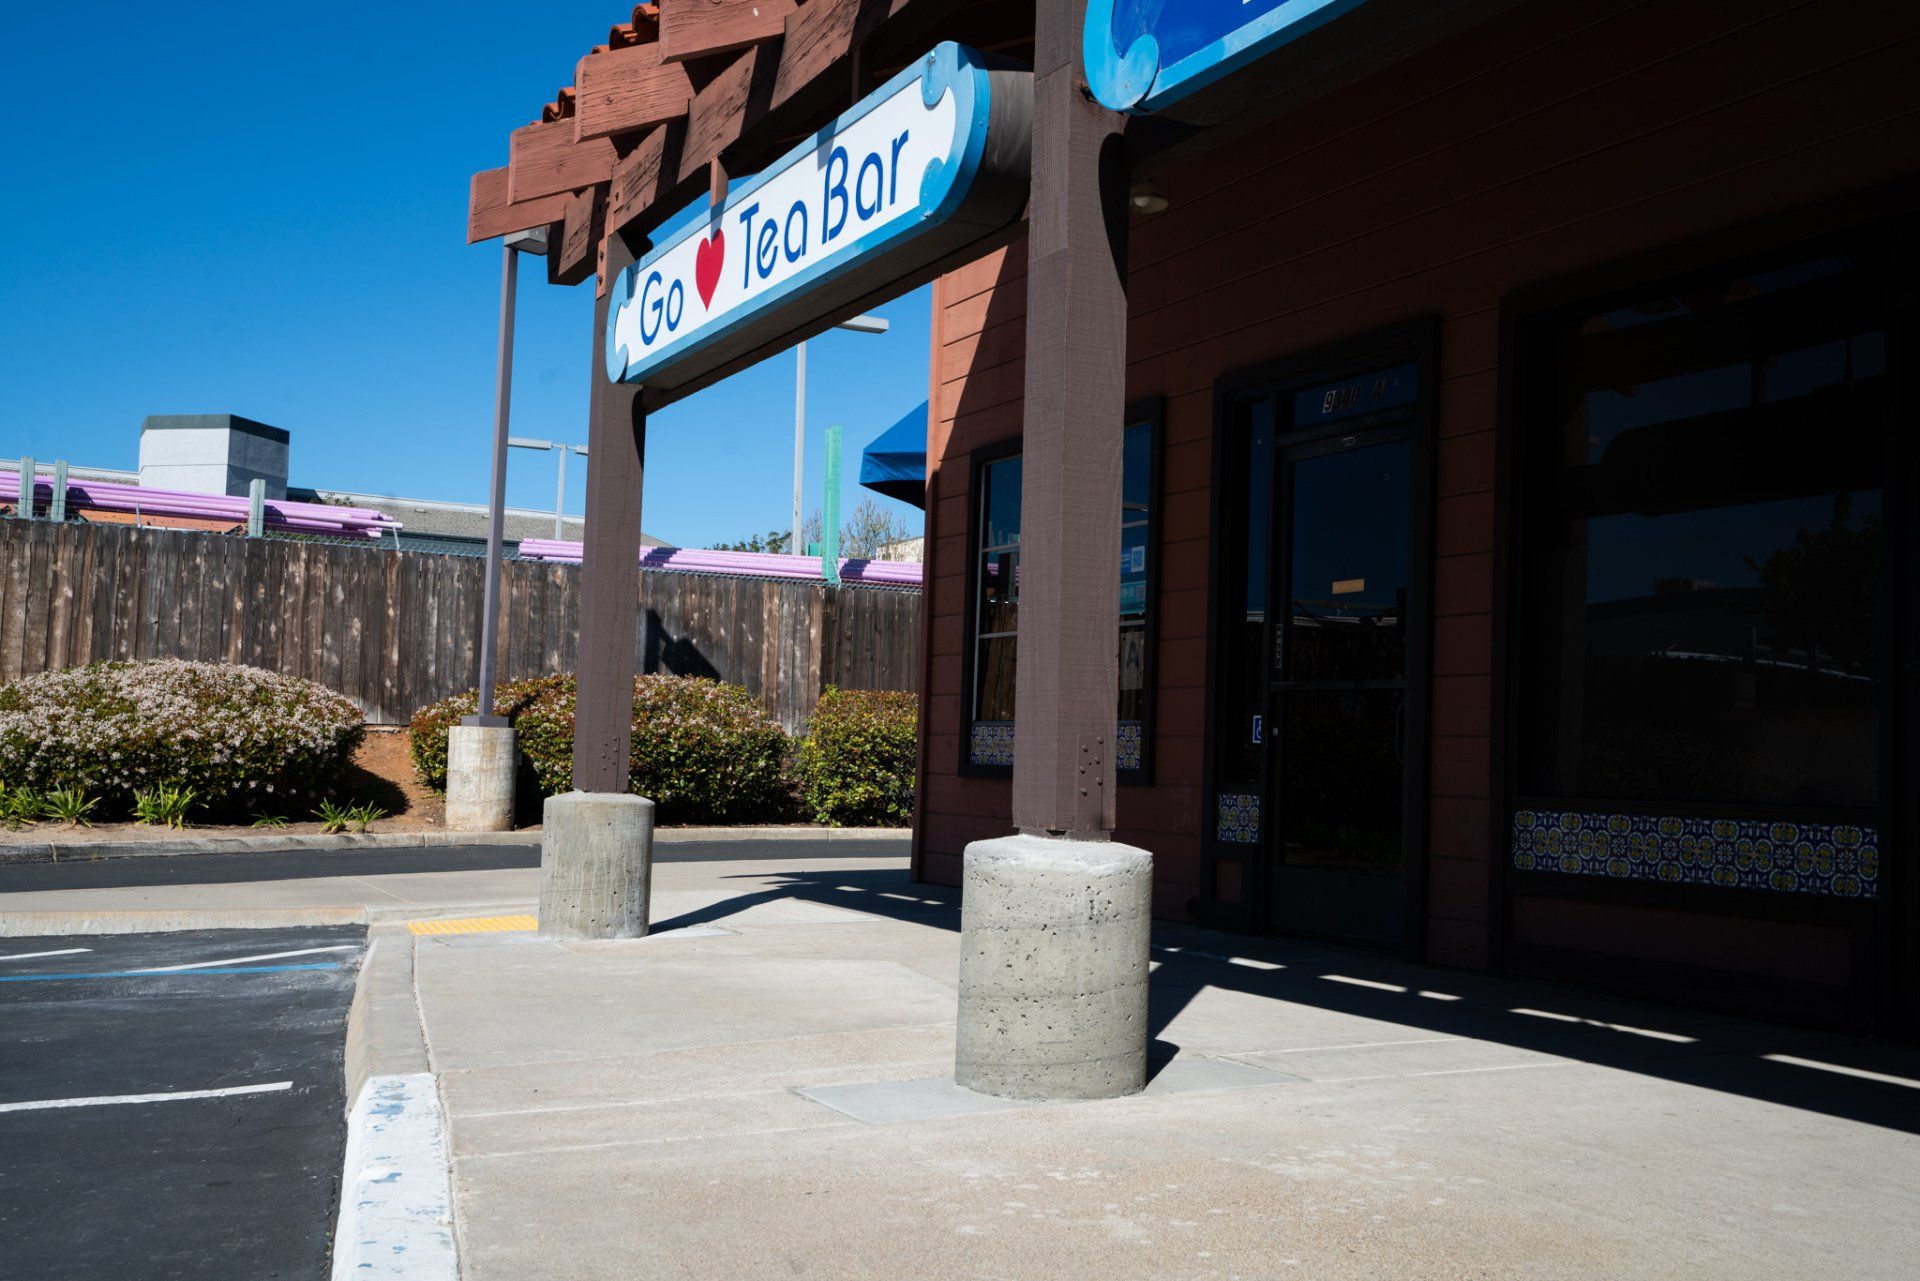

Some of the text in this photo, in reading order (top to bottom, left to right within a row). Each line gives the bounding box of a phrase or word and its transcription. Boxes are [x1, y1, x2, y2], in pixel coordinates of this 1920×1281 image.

[640, 130, 908, 345] Go Tea Bar
[1126, 640, 1140, 668] A
